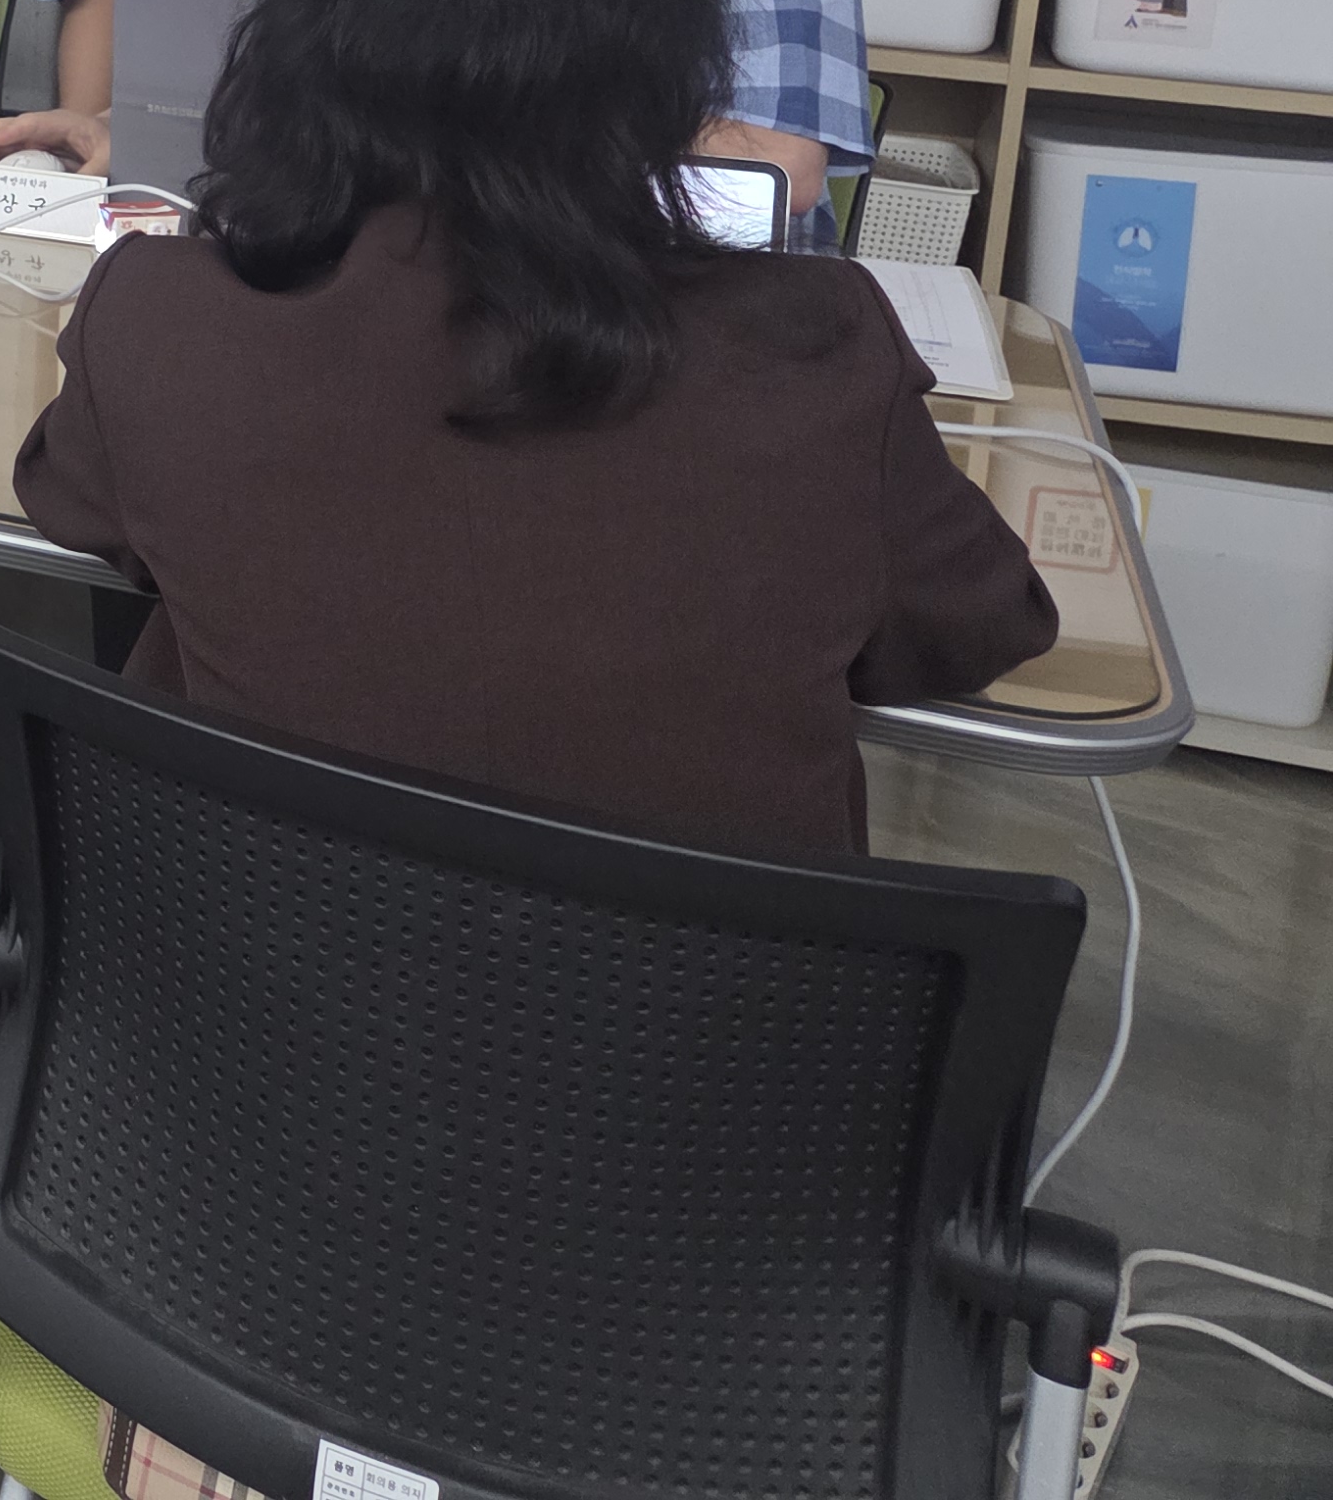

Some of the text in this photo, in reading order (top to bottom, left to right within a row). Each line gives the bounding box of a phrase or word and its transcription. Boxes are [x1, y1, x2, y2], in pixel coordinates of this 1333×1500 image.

[333, 1459, 423, 1500] 품명 회의용 의자
